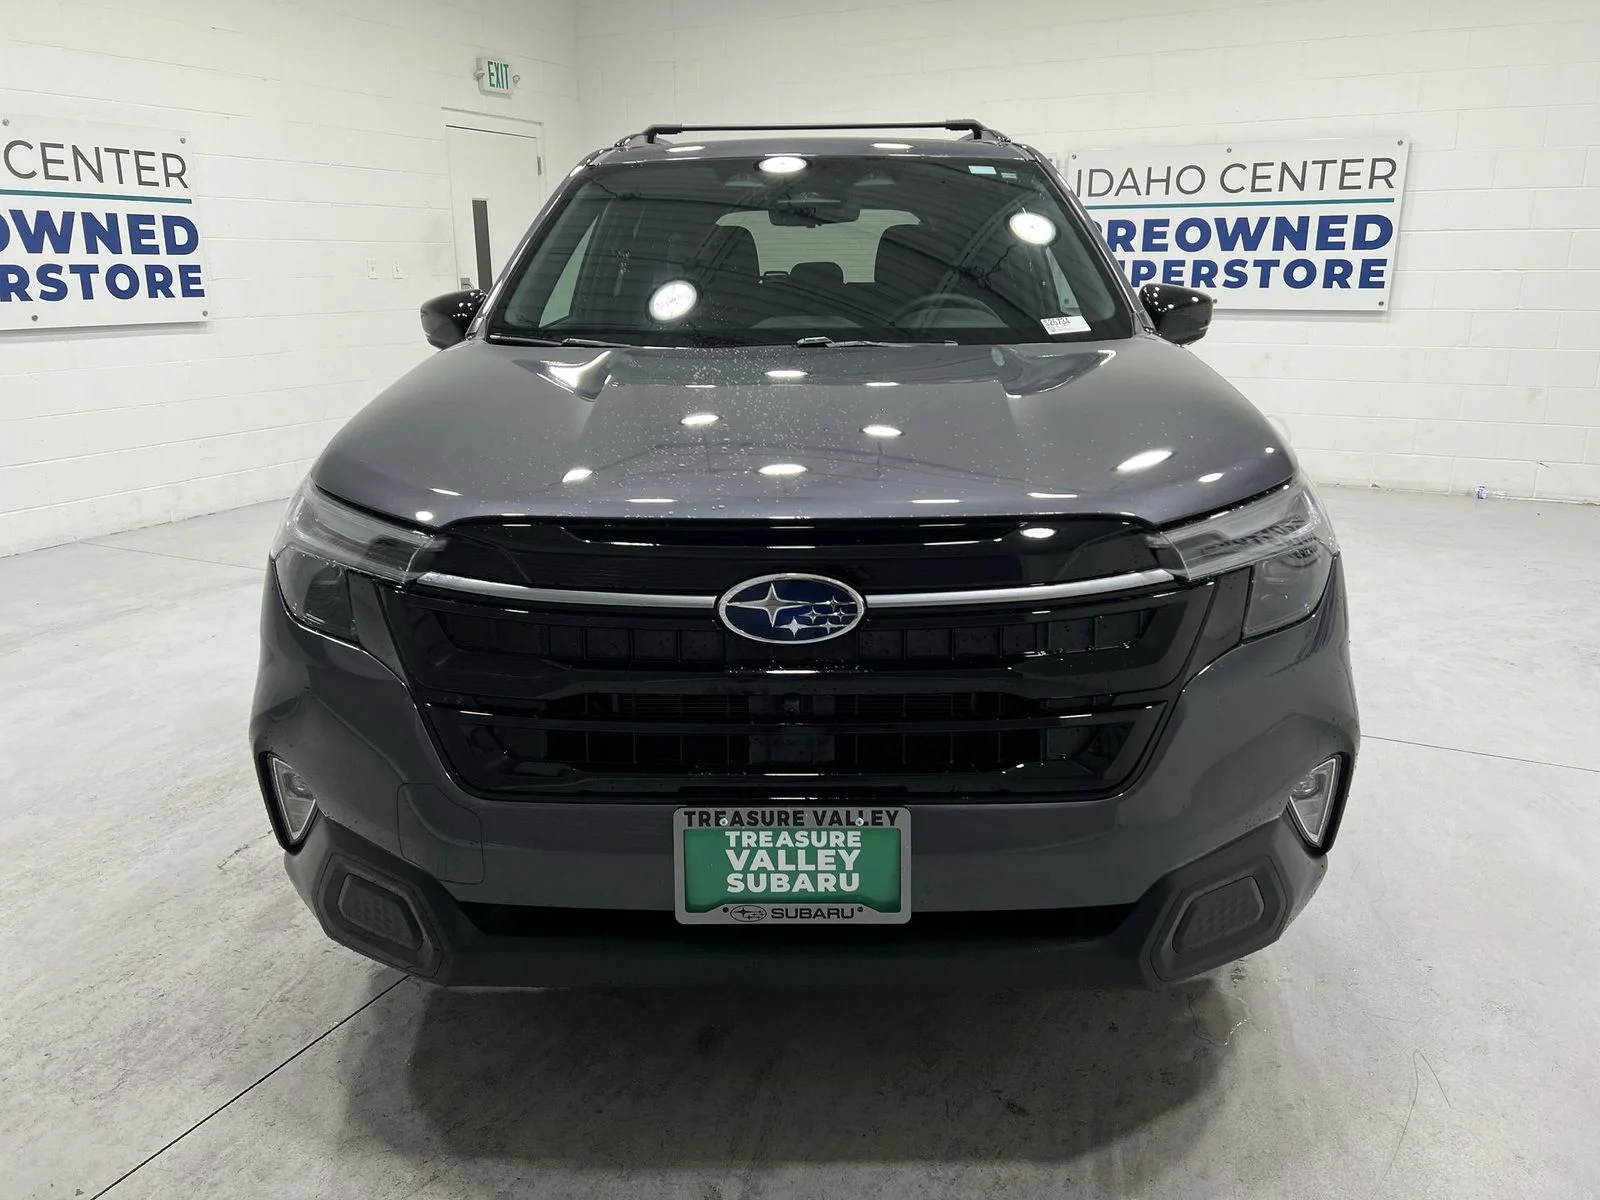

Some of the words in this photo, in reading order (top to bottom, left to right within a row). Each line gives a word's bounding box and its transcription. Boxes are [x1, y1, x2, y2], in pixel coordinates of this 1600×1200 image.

[488, 61, 509, 89] EXIT
[4, 140, 189, 189] CENTER
[1076, 164, 1206, 197] IDAHO
[1220, 157, 1397, 194] CENTER
[0, 208, 199, 255] WNED
[1117, 258, 1388, 289] PERSTORE
[683, 810, 805, 827] TREASURE
[813, 810, 899, 827] VALLEY
[725, 830, 862, 848] TREASURE
[725, 849, 861, 871] VALLEY
[726, 873, 860, 893] SUBARU
[771, 907, 855, 919] SUBARU
